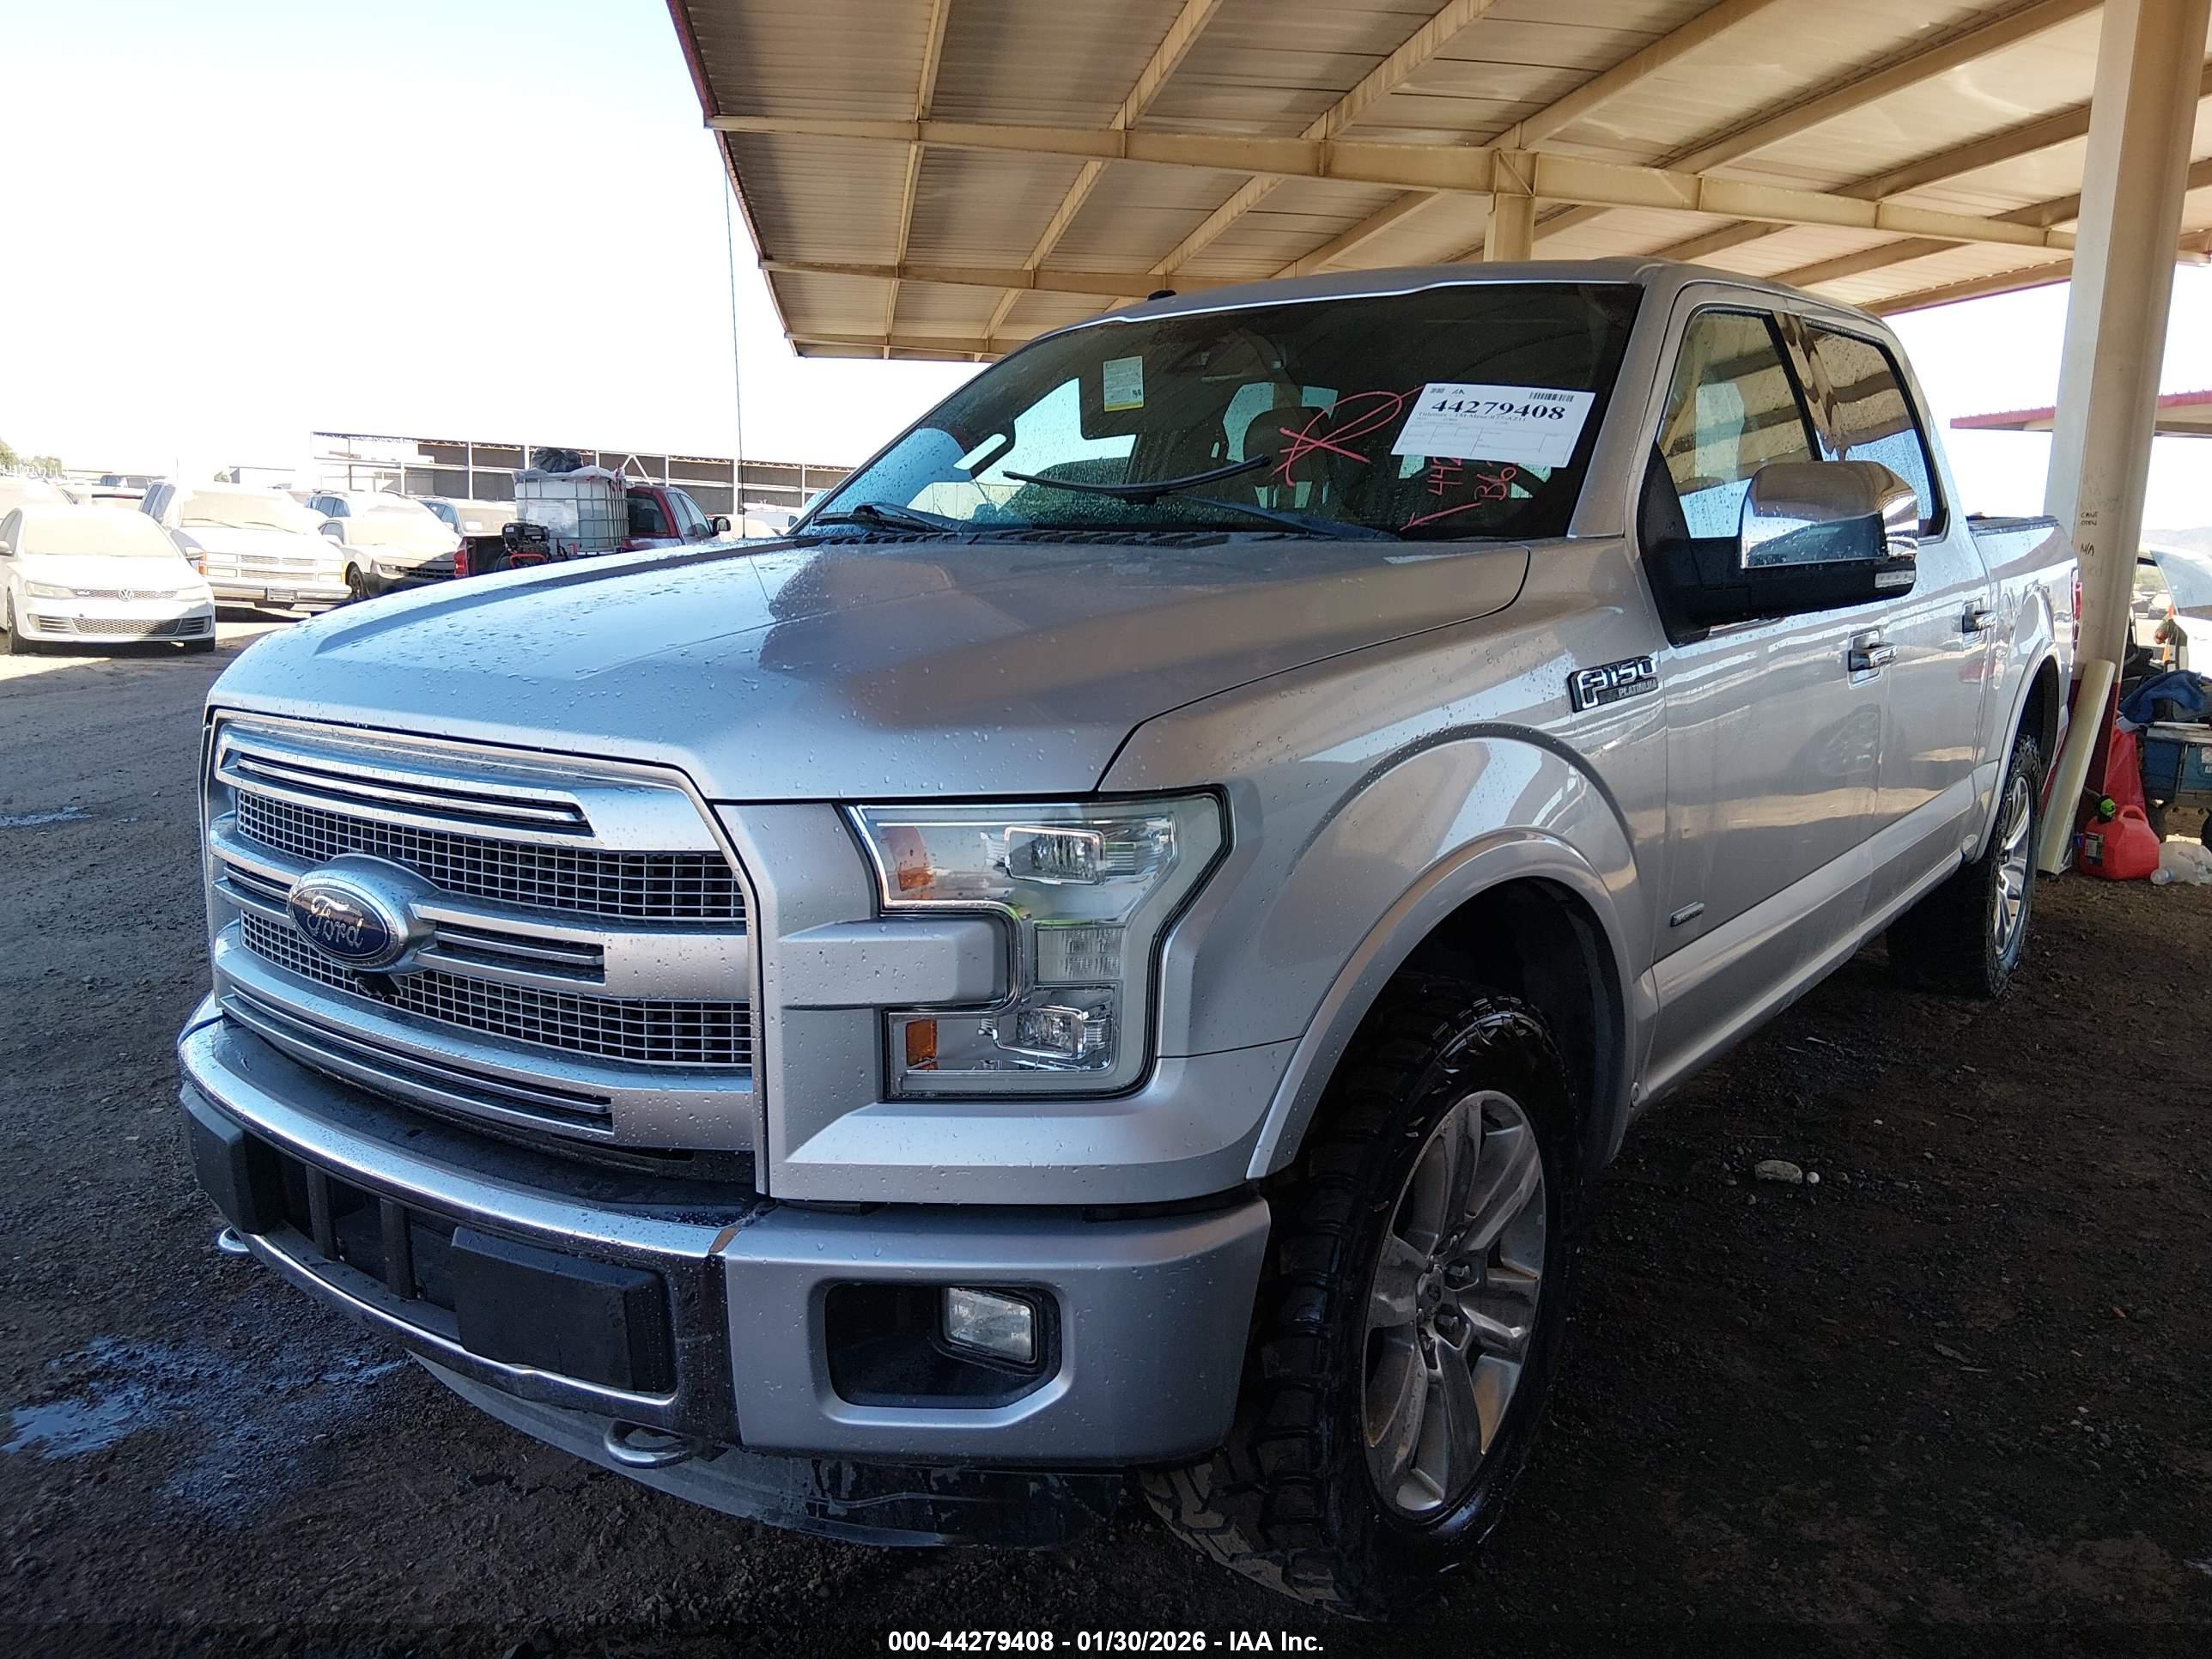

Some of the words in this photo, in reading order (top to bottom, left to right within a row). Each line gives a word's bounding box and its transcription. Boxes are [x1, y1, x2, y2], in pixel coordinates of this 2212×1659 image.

[1431, 399, 1566, 421] 44279408
[1618, 678, 1658, 698] PLATINUM
[307, 896, 365, 949] Ford
